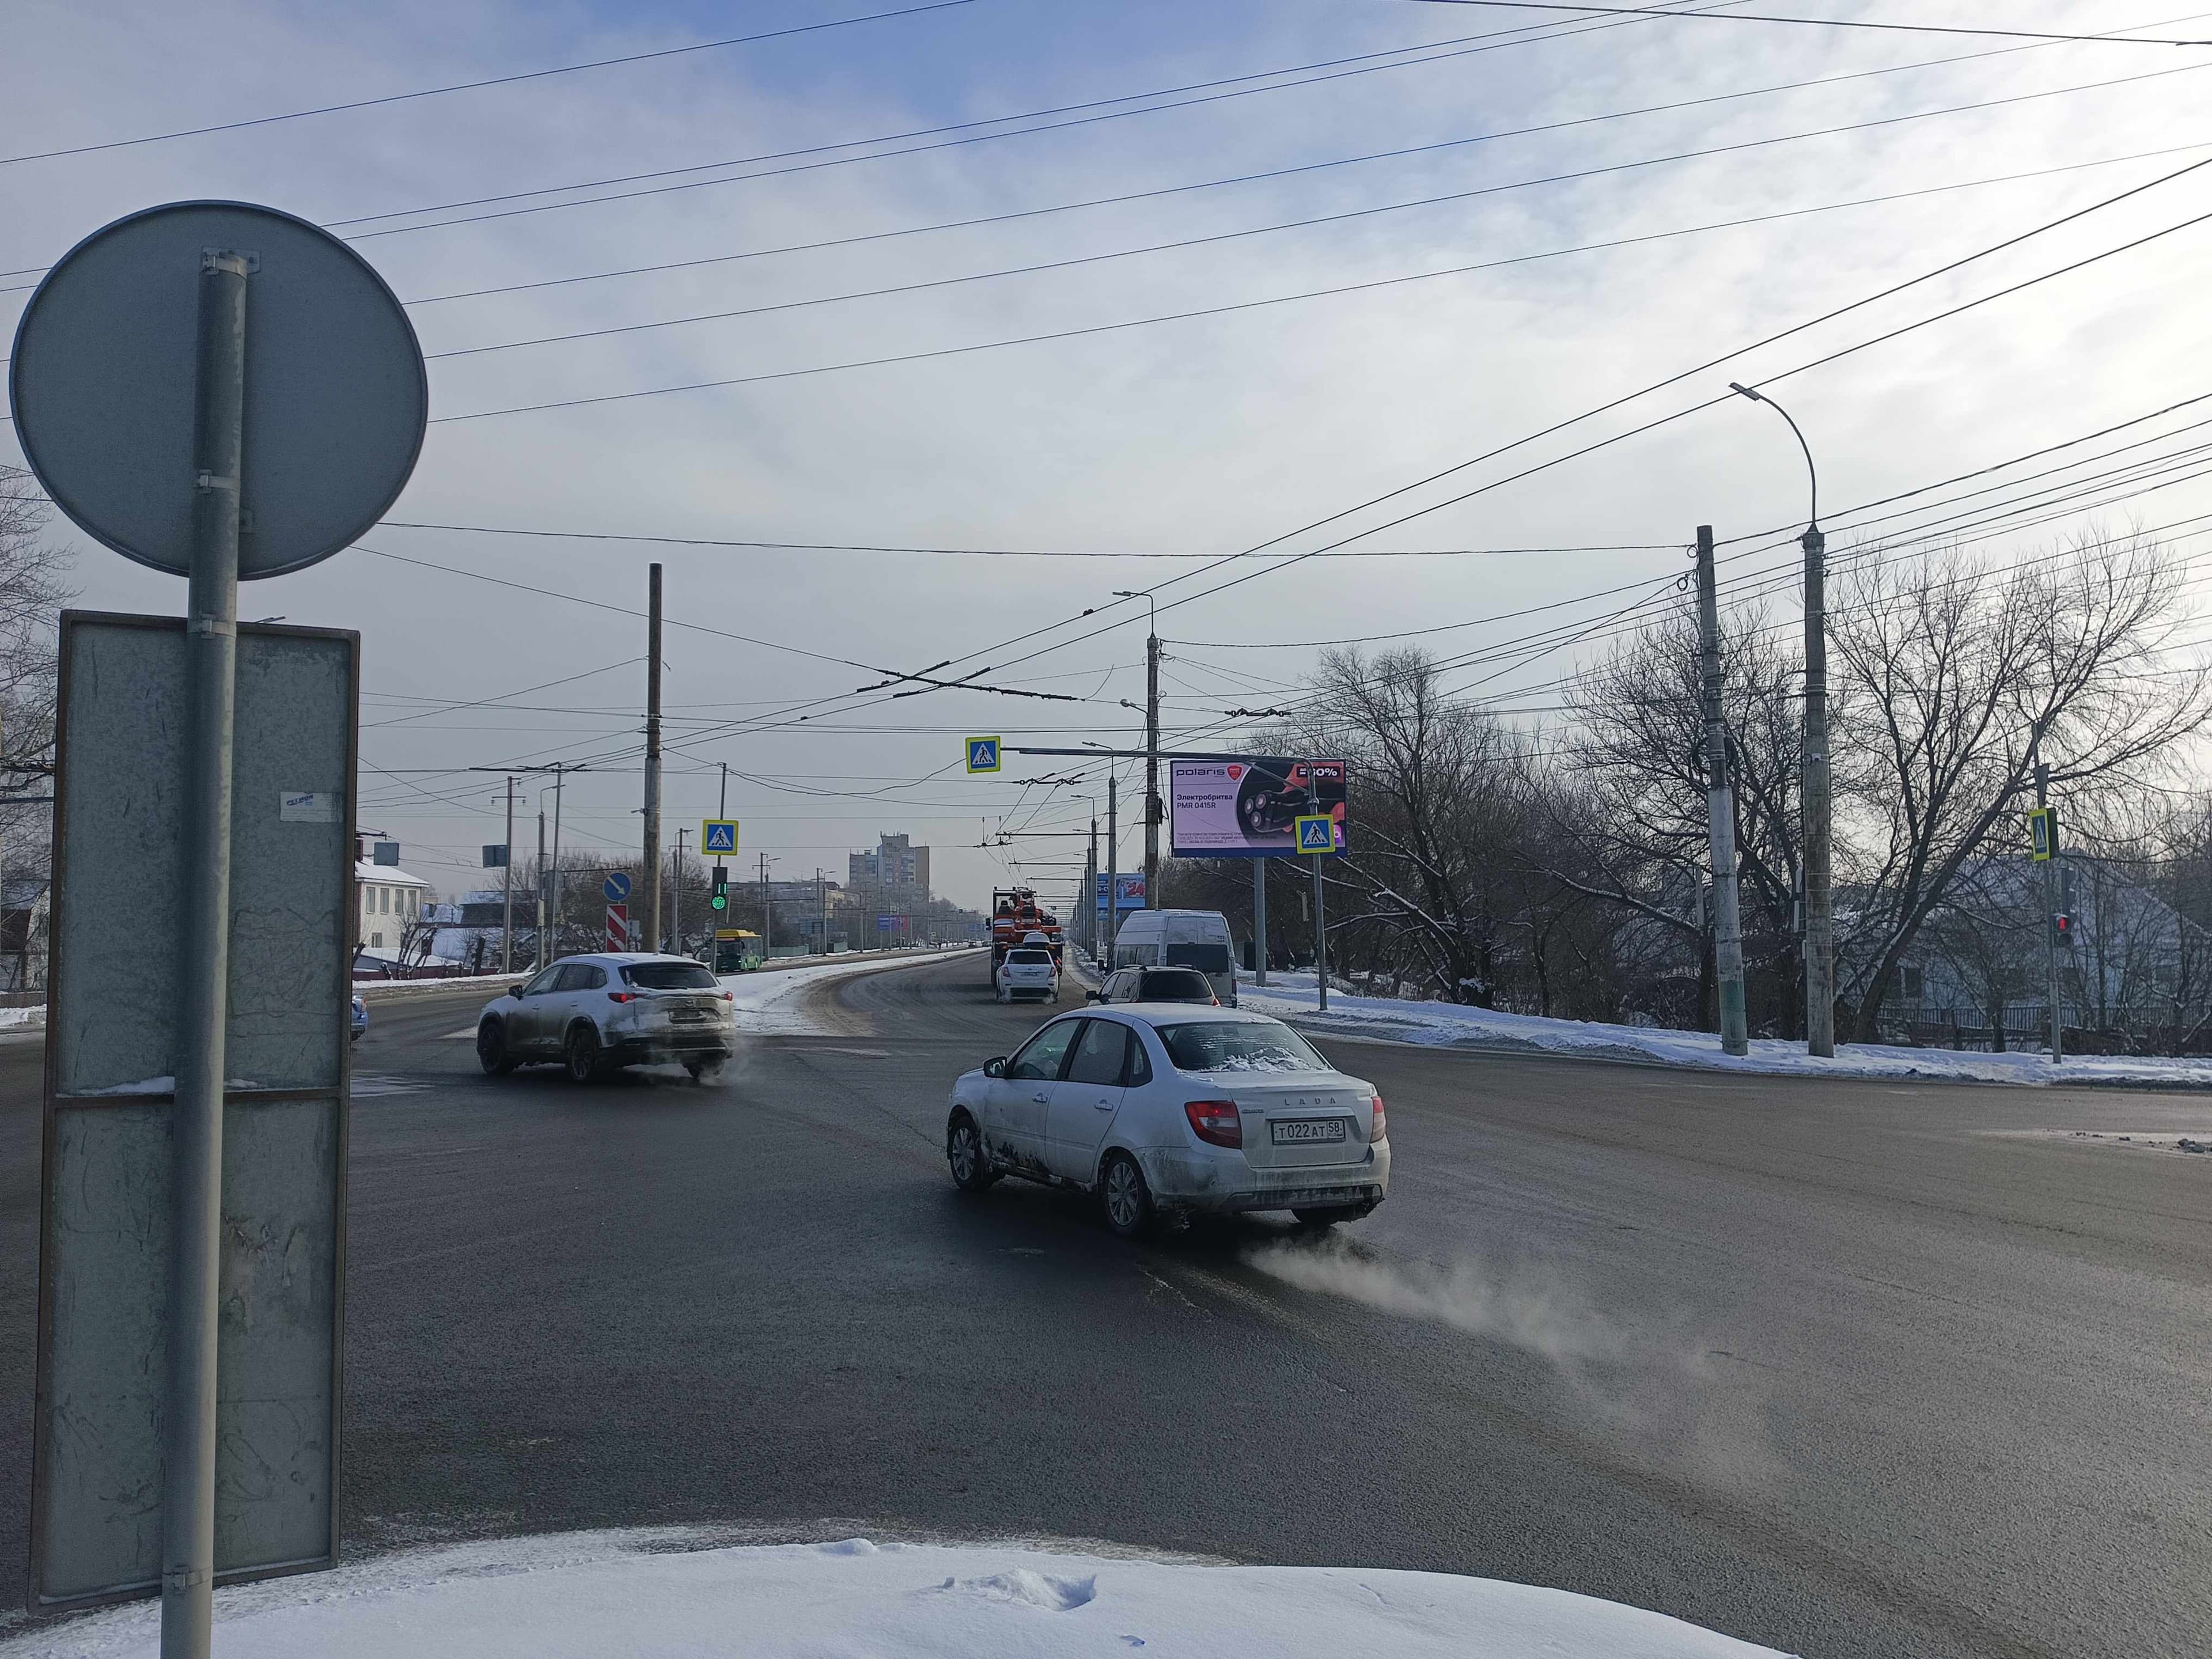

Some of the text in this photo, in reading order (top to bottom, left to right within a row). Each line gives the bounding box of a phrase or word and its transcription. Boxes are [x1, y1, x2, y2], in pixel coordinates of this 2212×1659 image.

[1176, 768, 1225, 777] polaris
[1285, 1097, 1336, 1105] LADA
[1328, 1122, 1340, 1132] 58
